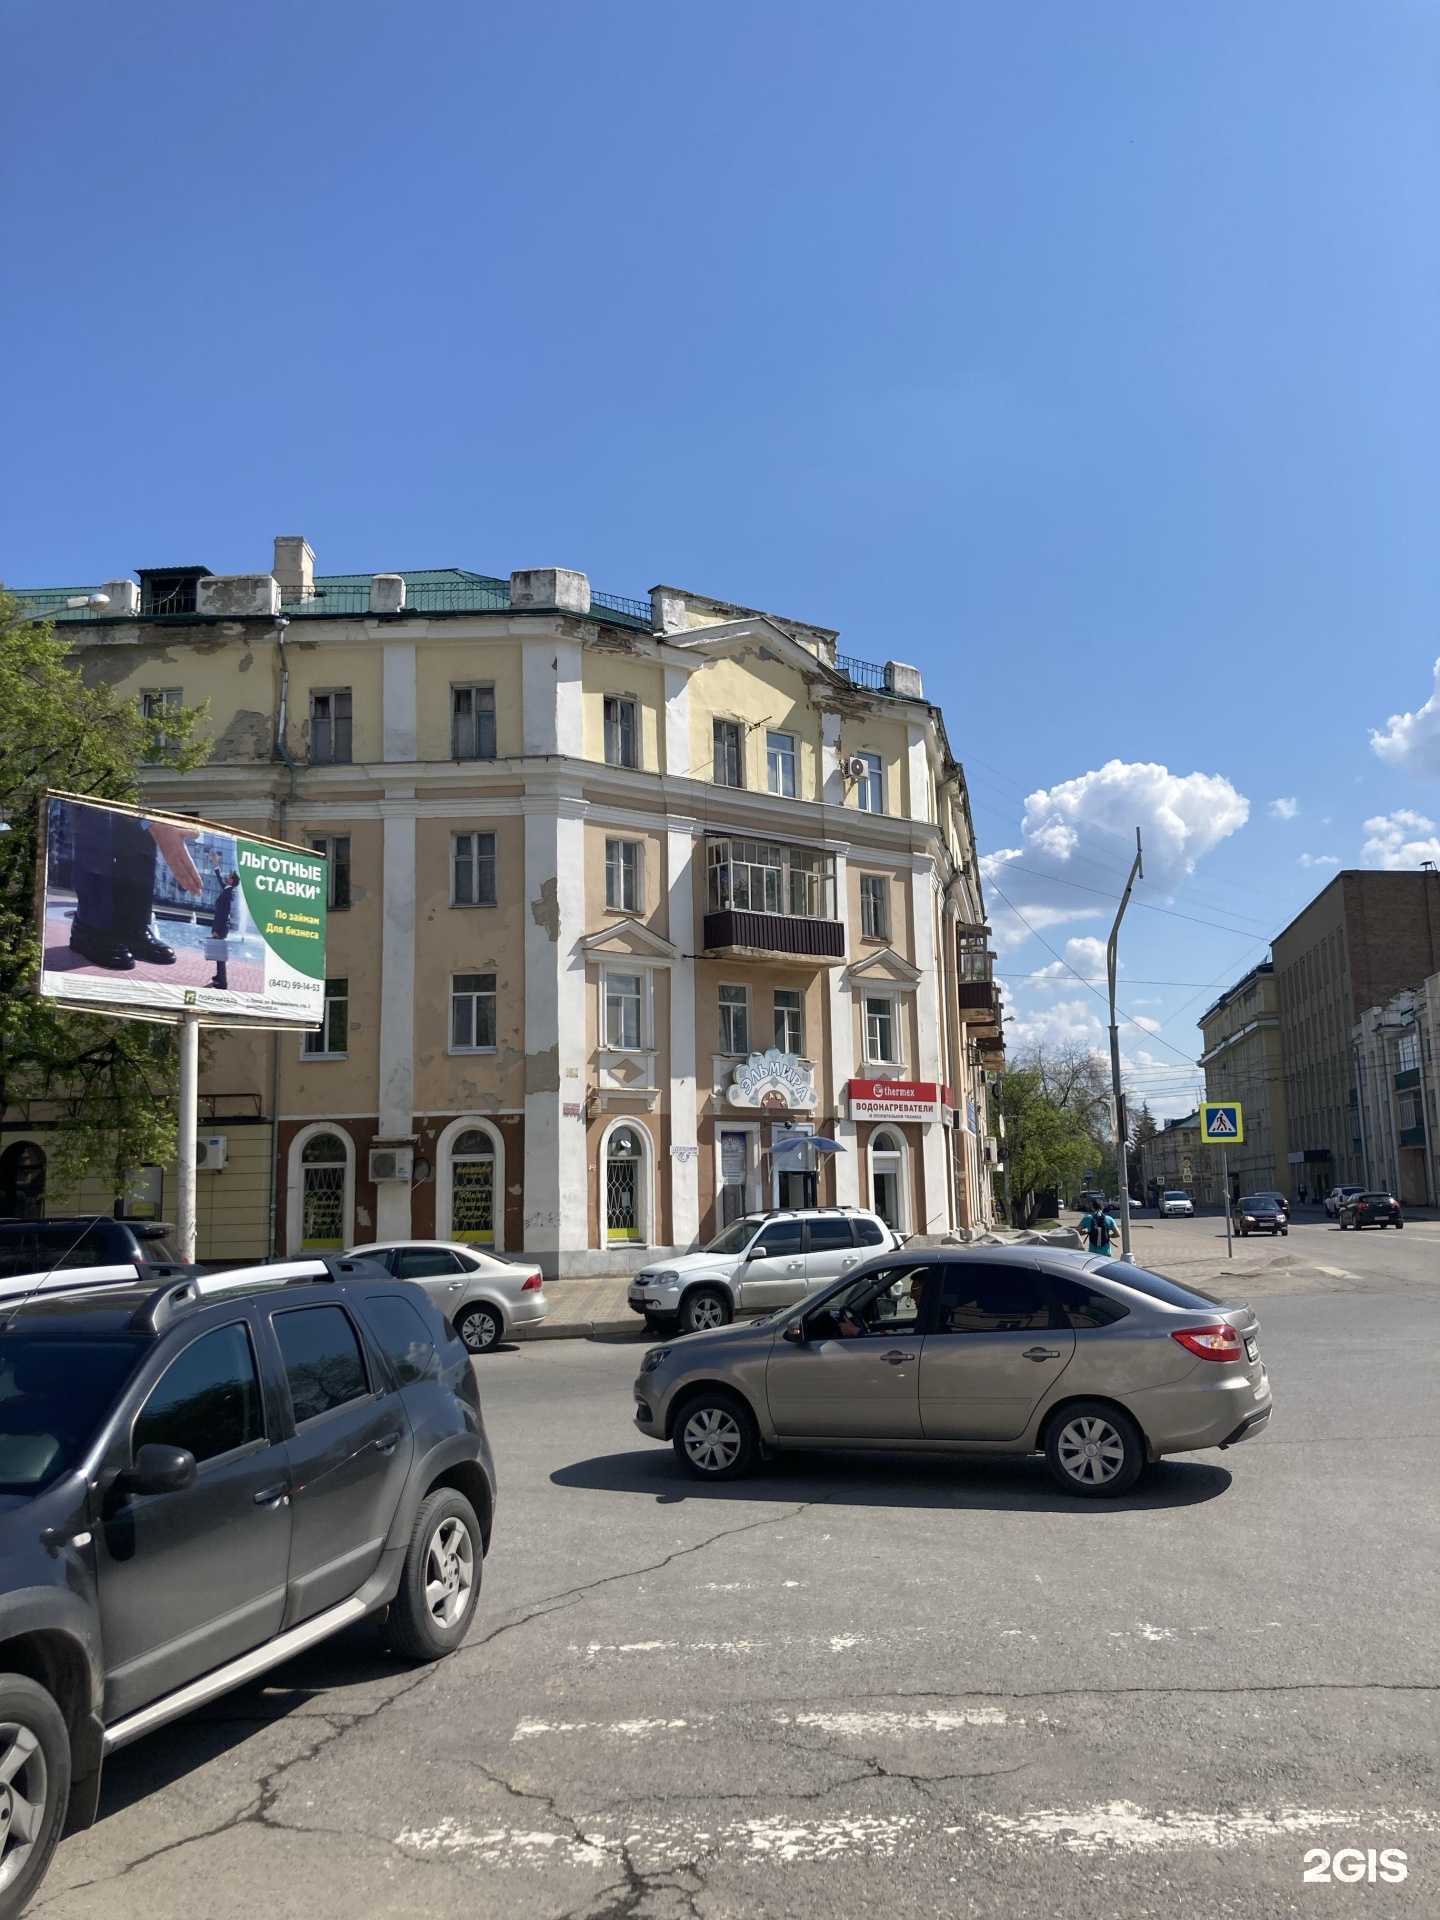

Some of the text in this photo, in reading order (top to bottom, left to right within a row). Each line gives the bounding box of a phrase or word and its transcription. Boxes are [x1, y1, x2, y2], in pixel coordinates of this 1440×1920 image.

[240, 851, 322, 881] ЛЬГОТНЫЕ
[275, 909, 288, 920] По
[266, 922, 320, 939] Для бизнеса
[741, 1062, 808, 1103] ЭЛЬМИРА
[884, 1086, 915, 1097] thermex
[856, 1103, 934, 1113] ВОДОНАГРЕВАТЕЛИ
